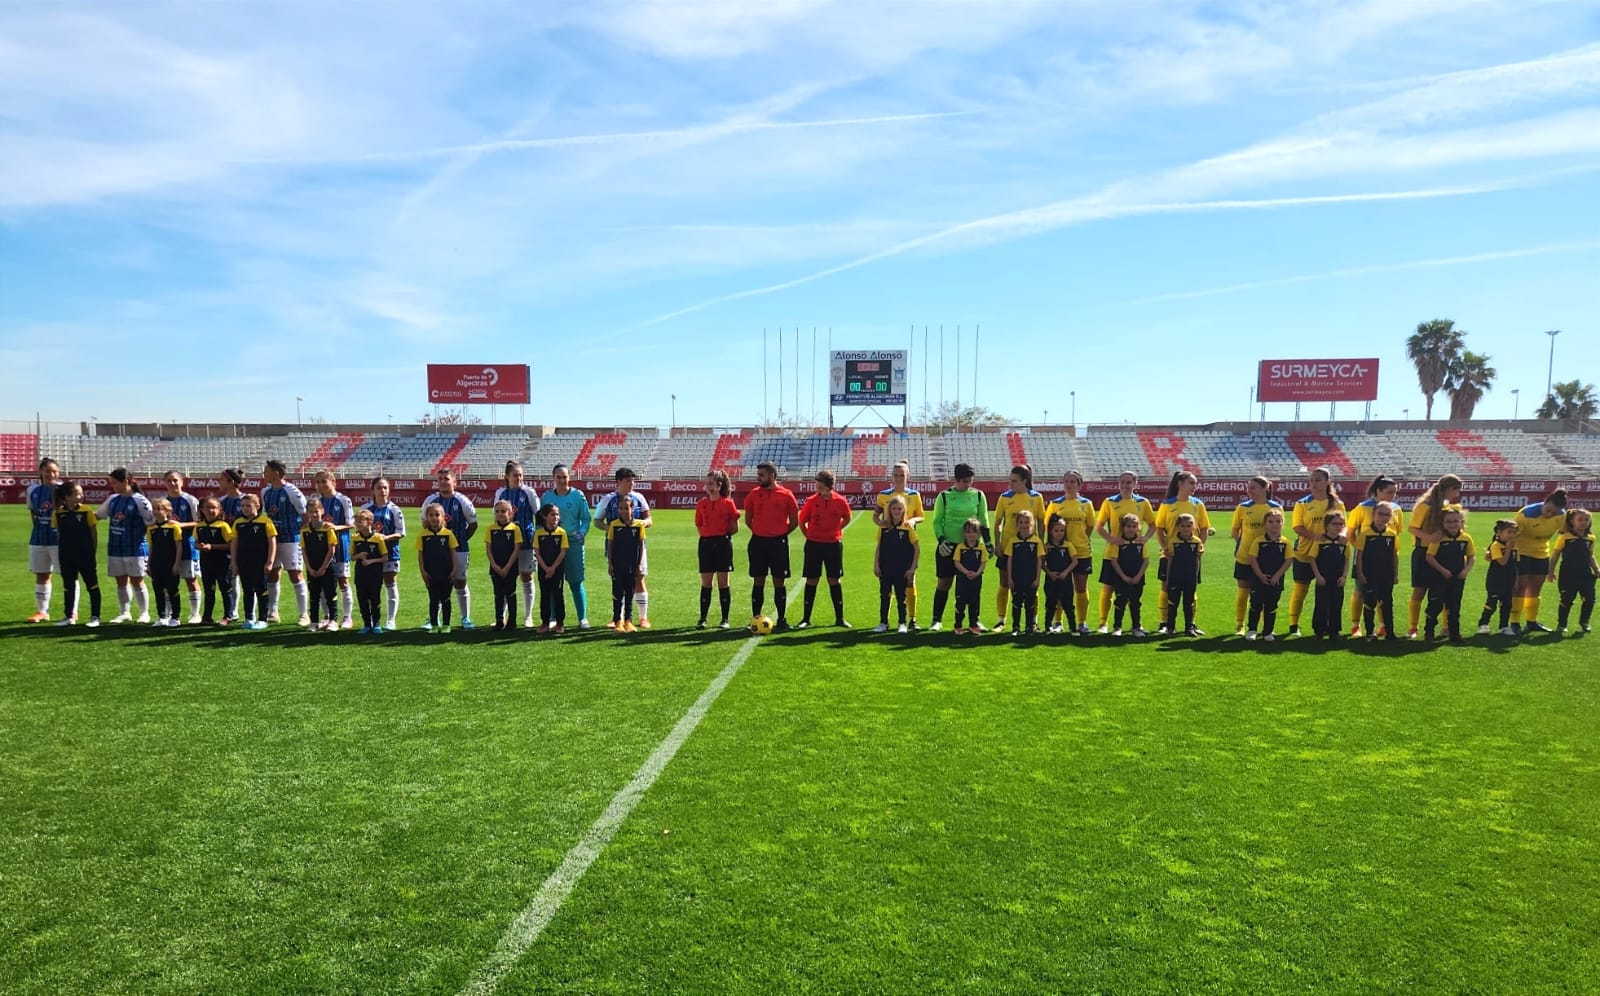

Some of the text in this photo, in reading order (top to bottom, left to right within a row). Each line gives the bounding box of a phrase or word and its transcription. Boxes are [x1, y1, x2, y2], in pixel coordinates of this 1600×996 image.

[835, 351, 902, 360] Alonso Alonso
[1270, 364, 1368, 378] SURMEYCA
[456, 379, 488, 387] Algeciras
[664, 482, 697, 491] Adecco
